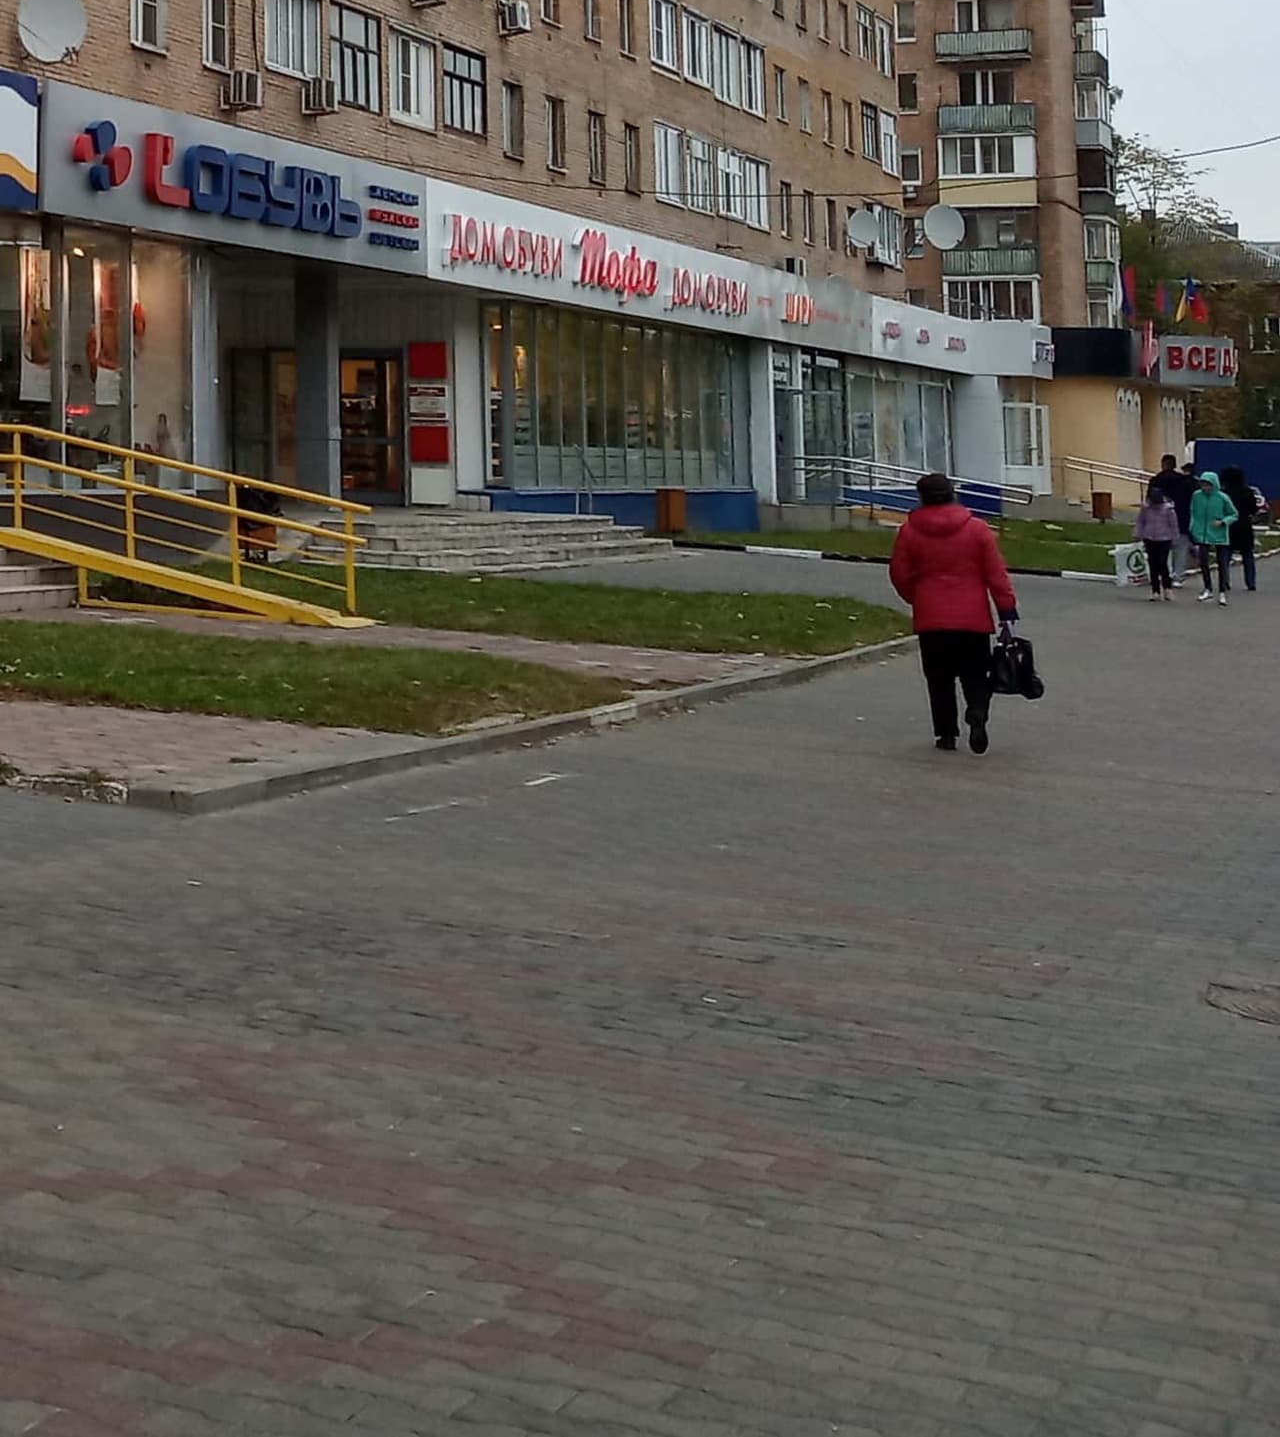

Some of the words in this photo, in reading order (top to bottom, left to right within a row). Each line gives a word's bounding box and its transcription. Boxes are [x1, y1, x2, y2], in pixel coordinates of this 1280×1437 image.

[449, 214, 496, 265] ДОМ
[502, 226, 563, 279] ОБУВИ
[1167, 345, 1217, 371] ВСЕ
